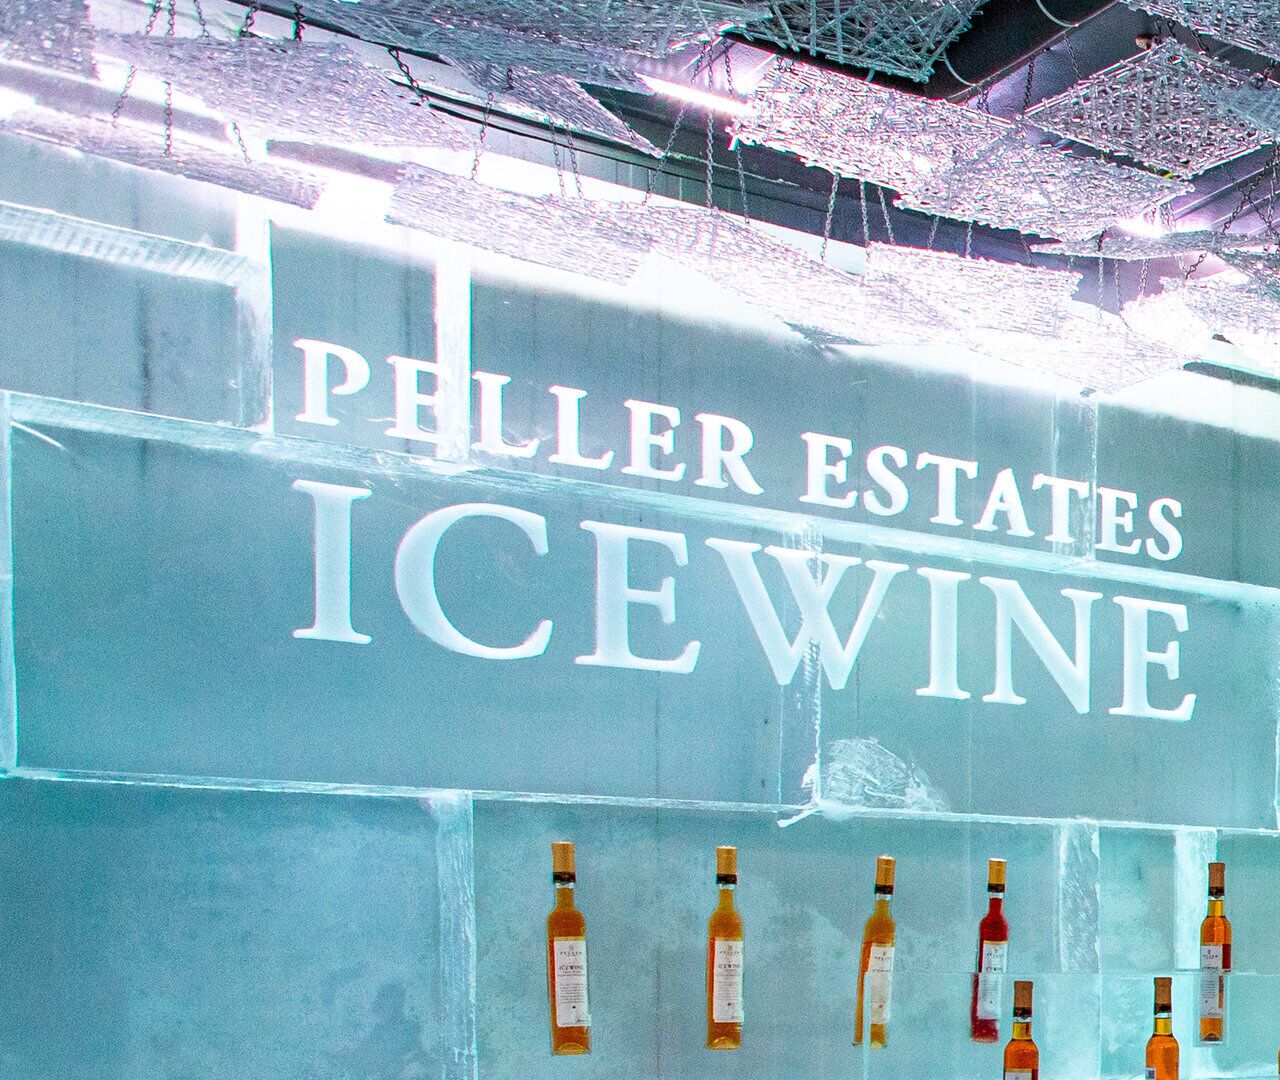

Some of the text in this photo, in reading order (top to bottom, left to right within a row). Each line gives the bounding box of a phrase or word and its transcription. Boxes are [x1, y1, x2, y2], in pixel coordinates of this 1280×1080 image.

[294, 337, 1184, 562] PELLER ESTATES
[292, 478, 1198, 723] ICEWINE
